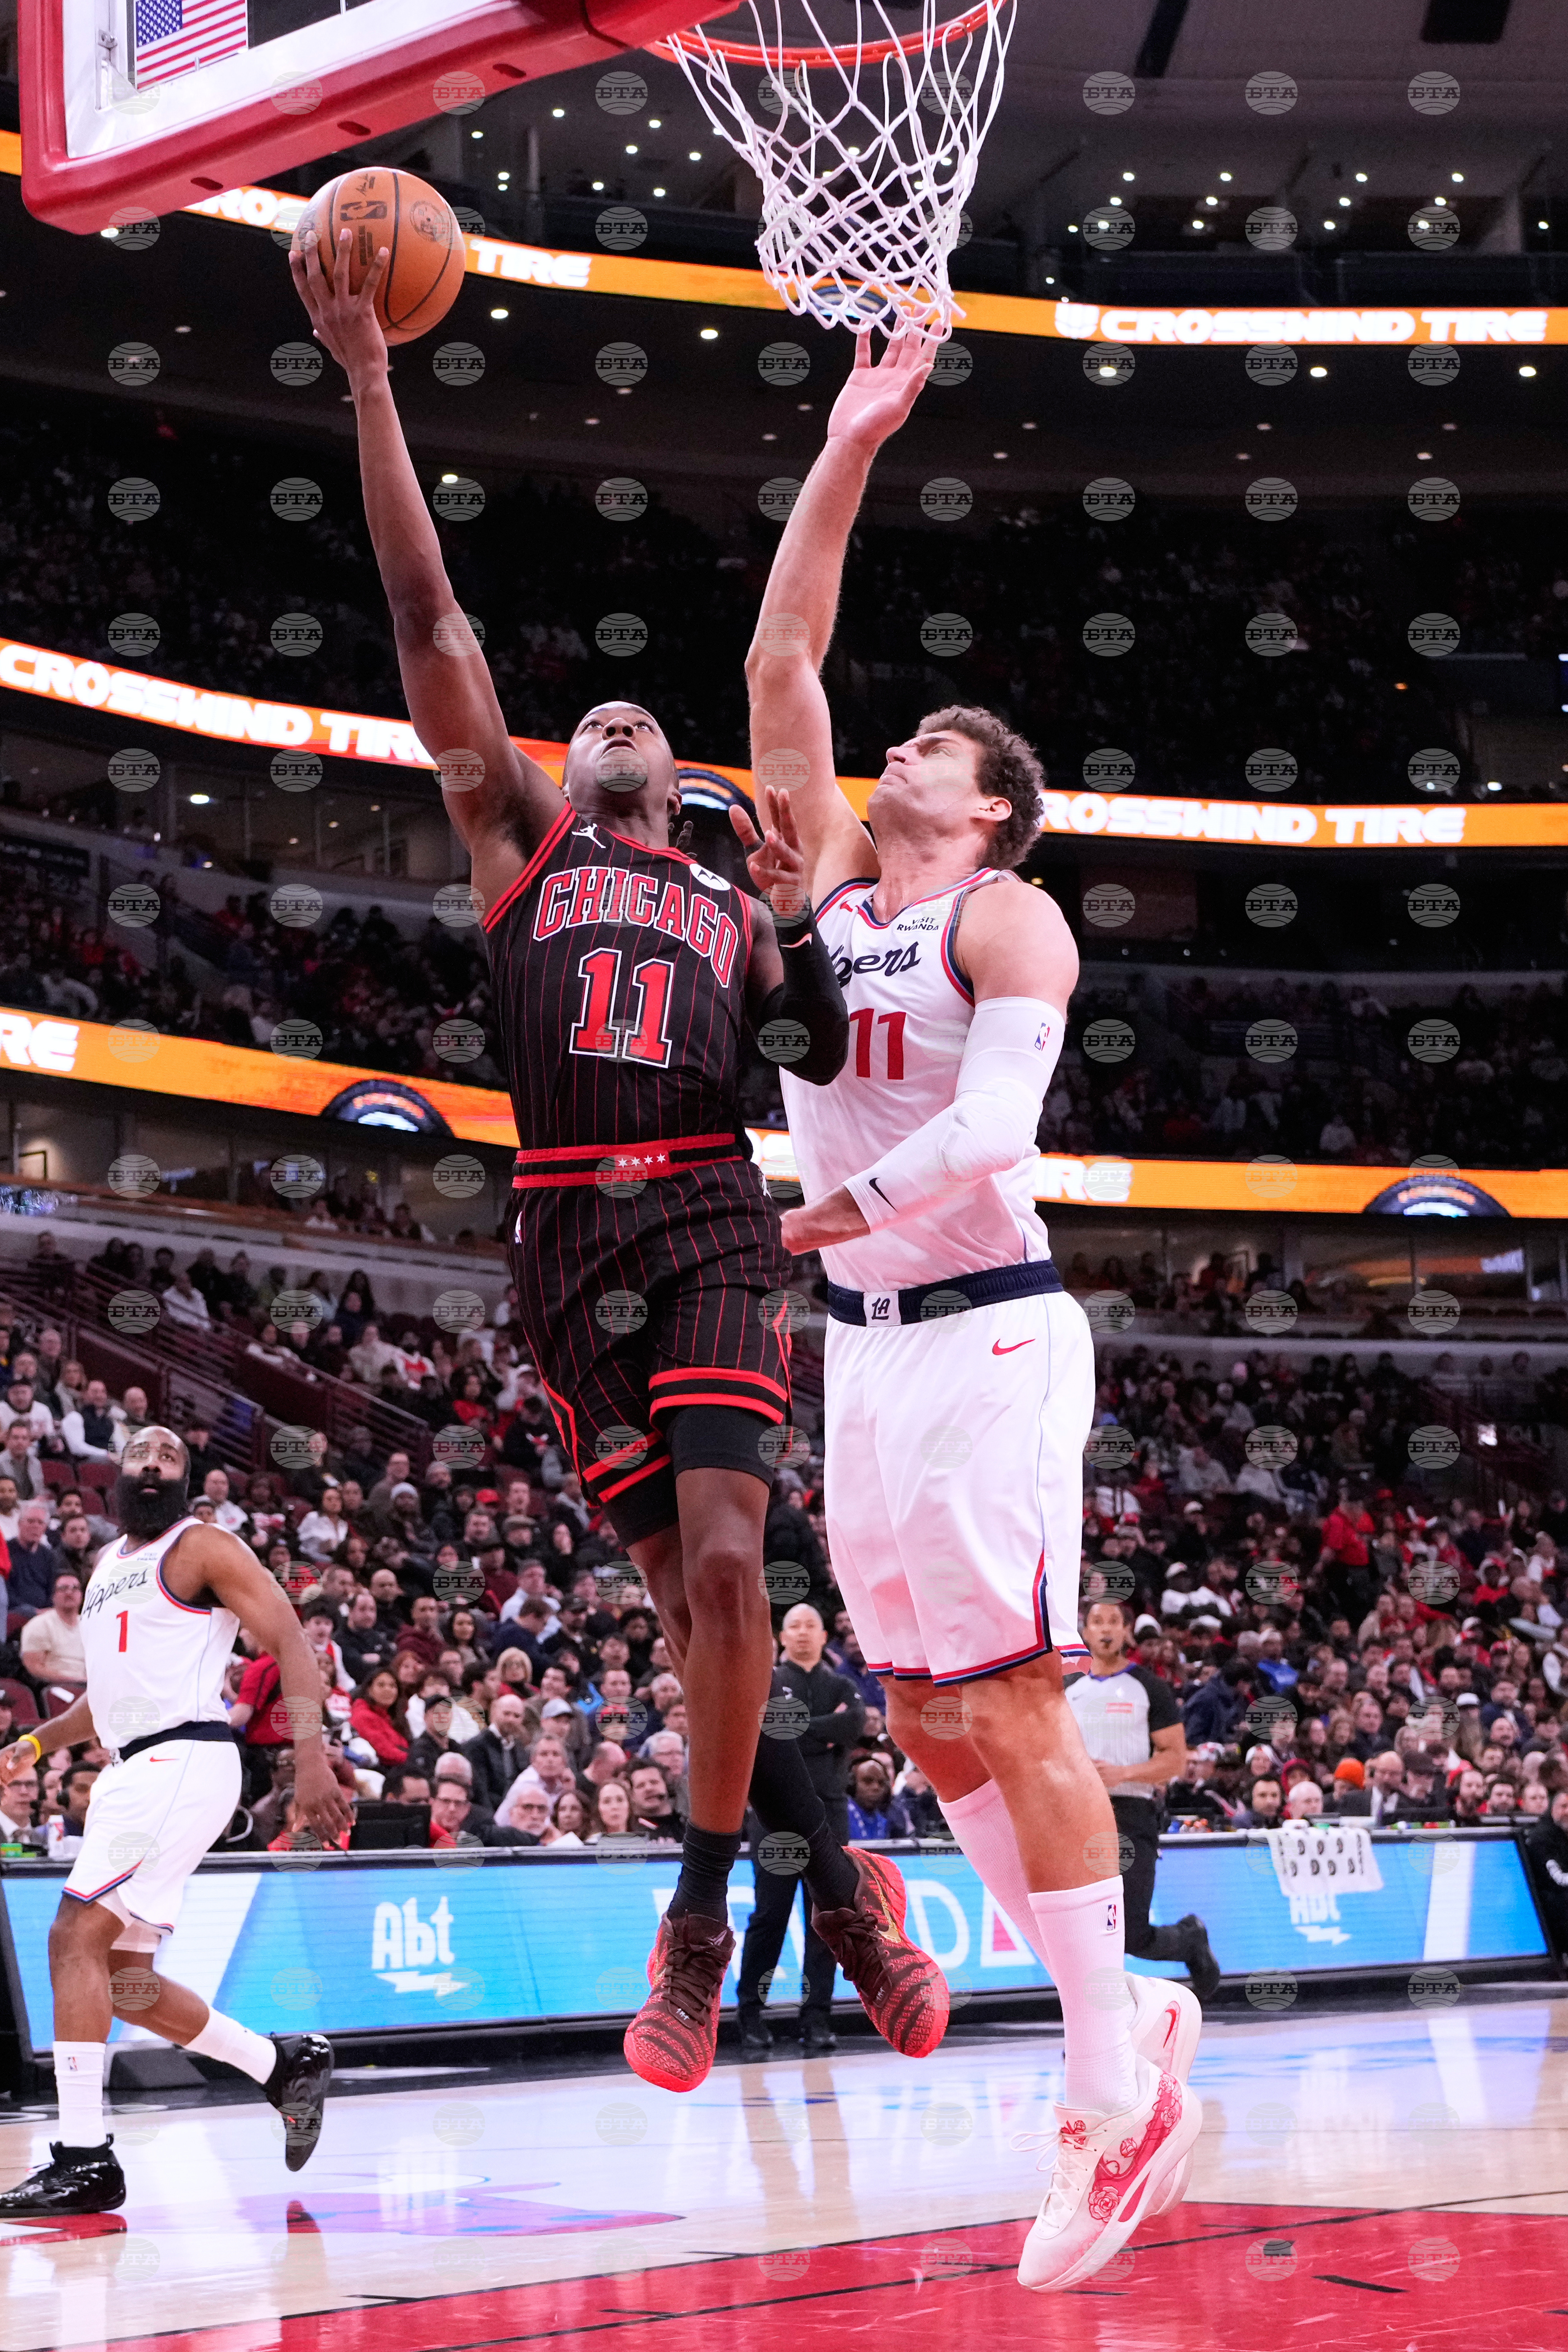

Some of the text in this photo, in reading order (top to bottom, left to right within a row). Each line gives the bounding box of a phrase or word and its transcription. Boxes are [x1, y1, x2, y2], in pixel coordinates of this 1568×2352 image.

[470, 239, 592, 287] TIRE
[1100, 310, 1548, 343] CROSSWIND TIRE
[0, 645, 313, 745] CROSSWIND
[1037, 791, 1466, 843] ROSSWIND TIRE
[533, 866, 738, 988] CHICAGO
[569, 947, 674, 1069] 11
[850, 1008, 906, 1080] 11
[1033, 1157, 1133, 1202] IRE
[872, 1296, 891, 1321] LA
[116, 1610, 128, 1652] 1
[371, 1896, 455, 1969] Abt
